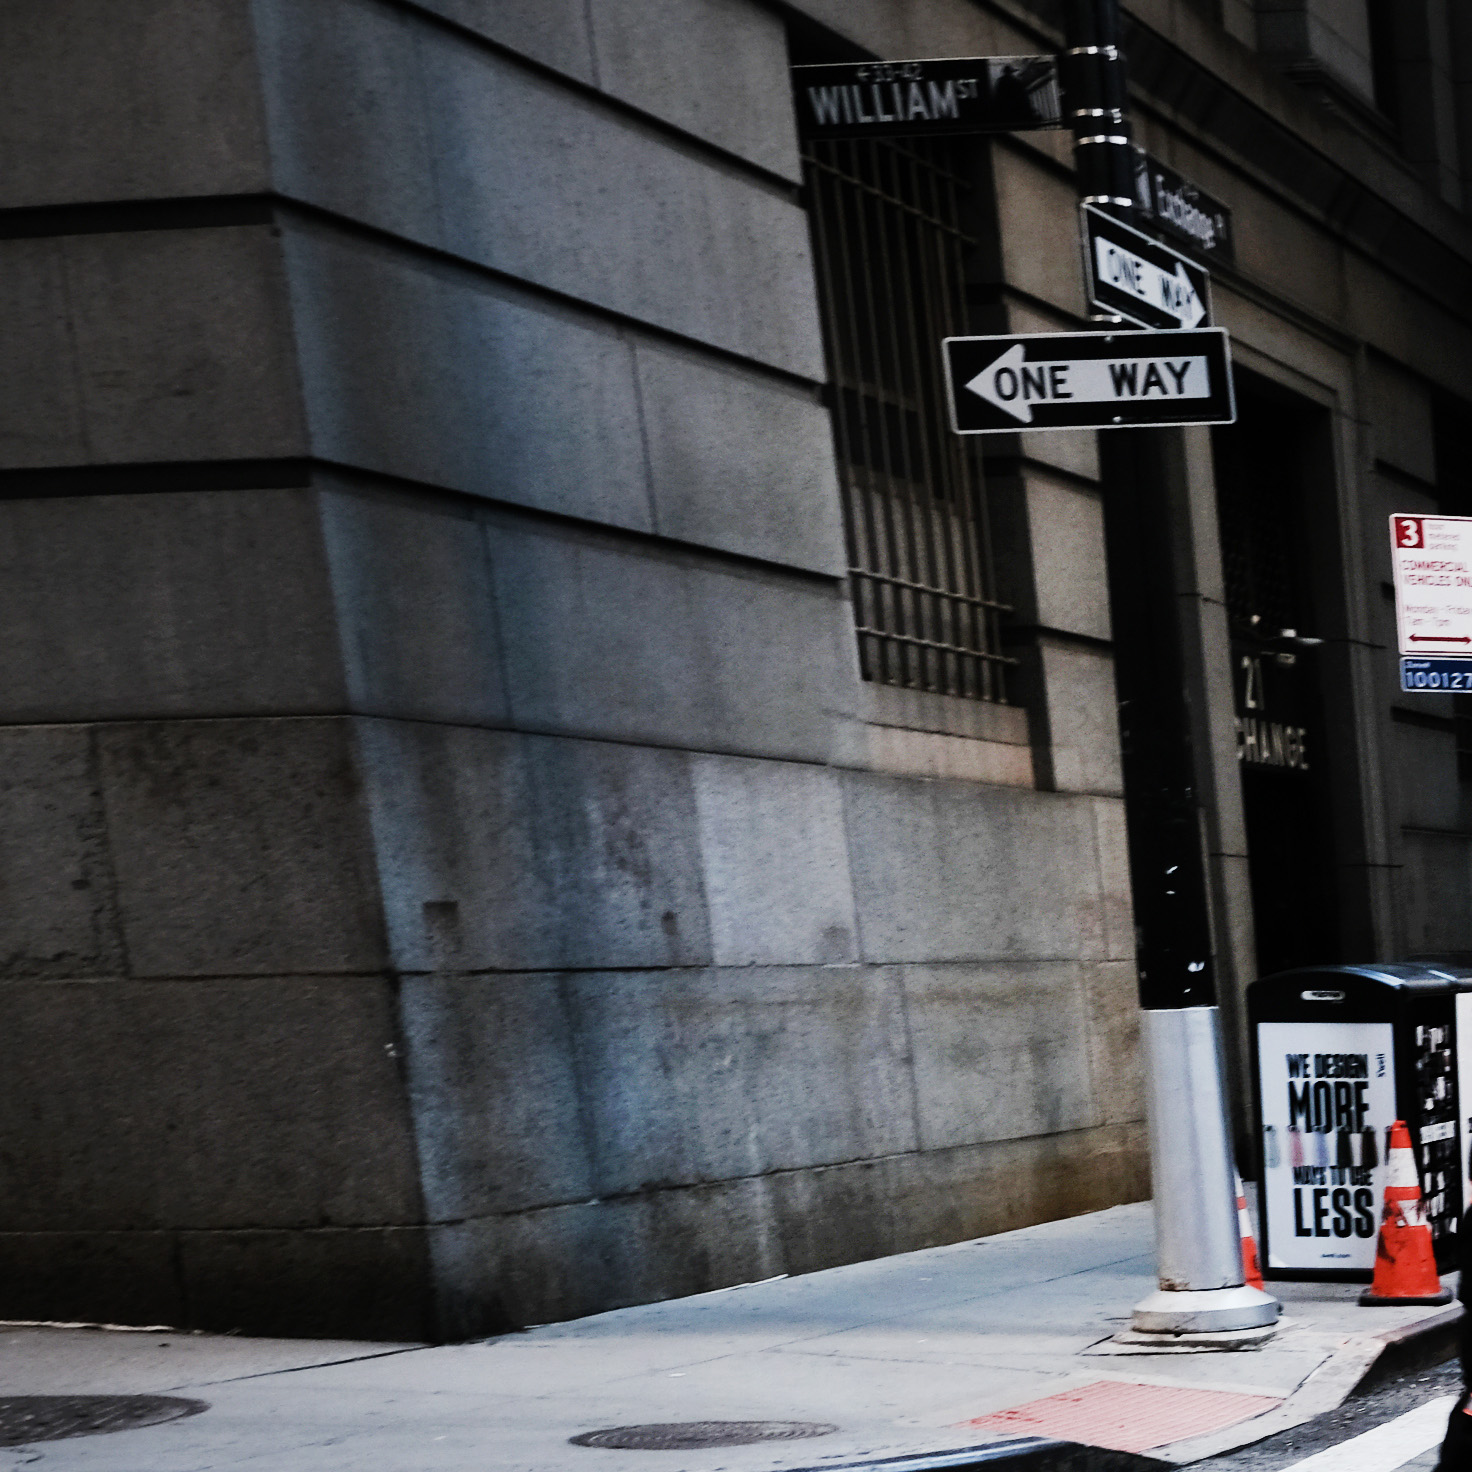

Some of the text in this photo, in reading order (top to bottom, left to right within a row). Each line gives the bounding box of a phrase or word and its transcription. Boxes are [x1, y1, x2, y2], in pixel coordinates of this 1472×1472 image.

[808, 79, 978, 125] WILLIAM ST
[1107, 248, 1197, 322] ONE WAY
[994, 361, 1190, 401] ONE WAY
[1400, 520, 1419, 546] 3
[1401, 559, 1469, 572] COMMERCIAL
[1286, 1054, 1367, 1078] WE DESIGN
[1288, 1081, 1369, 1133] MORE
[1294, 1187, 1375, 1238] LESS
